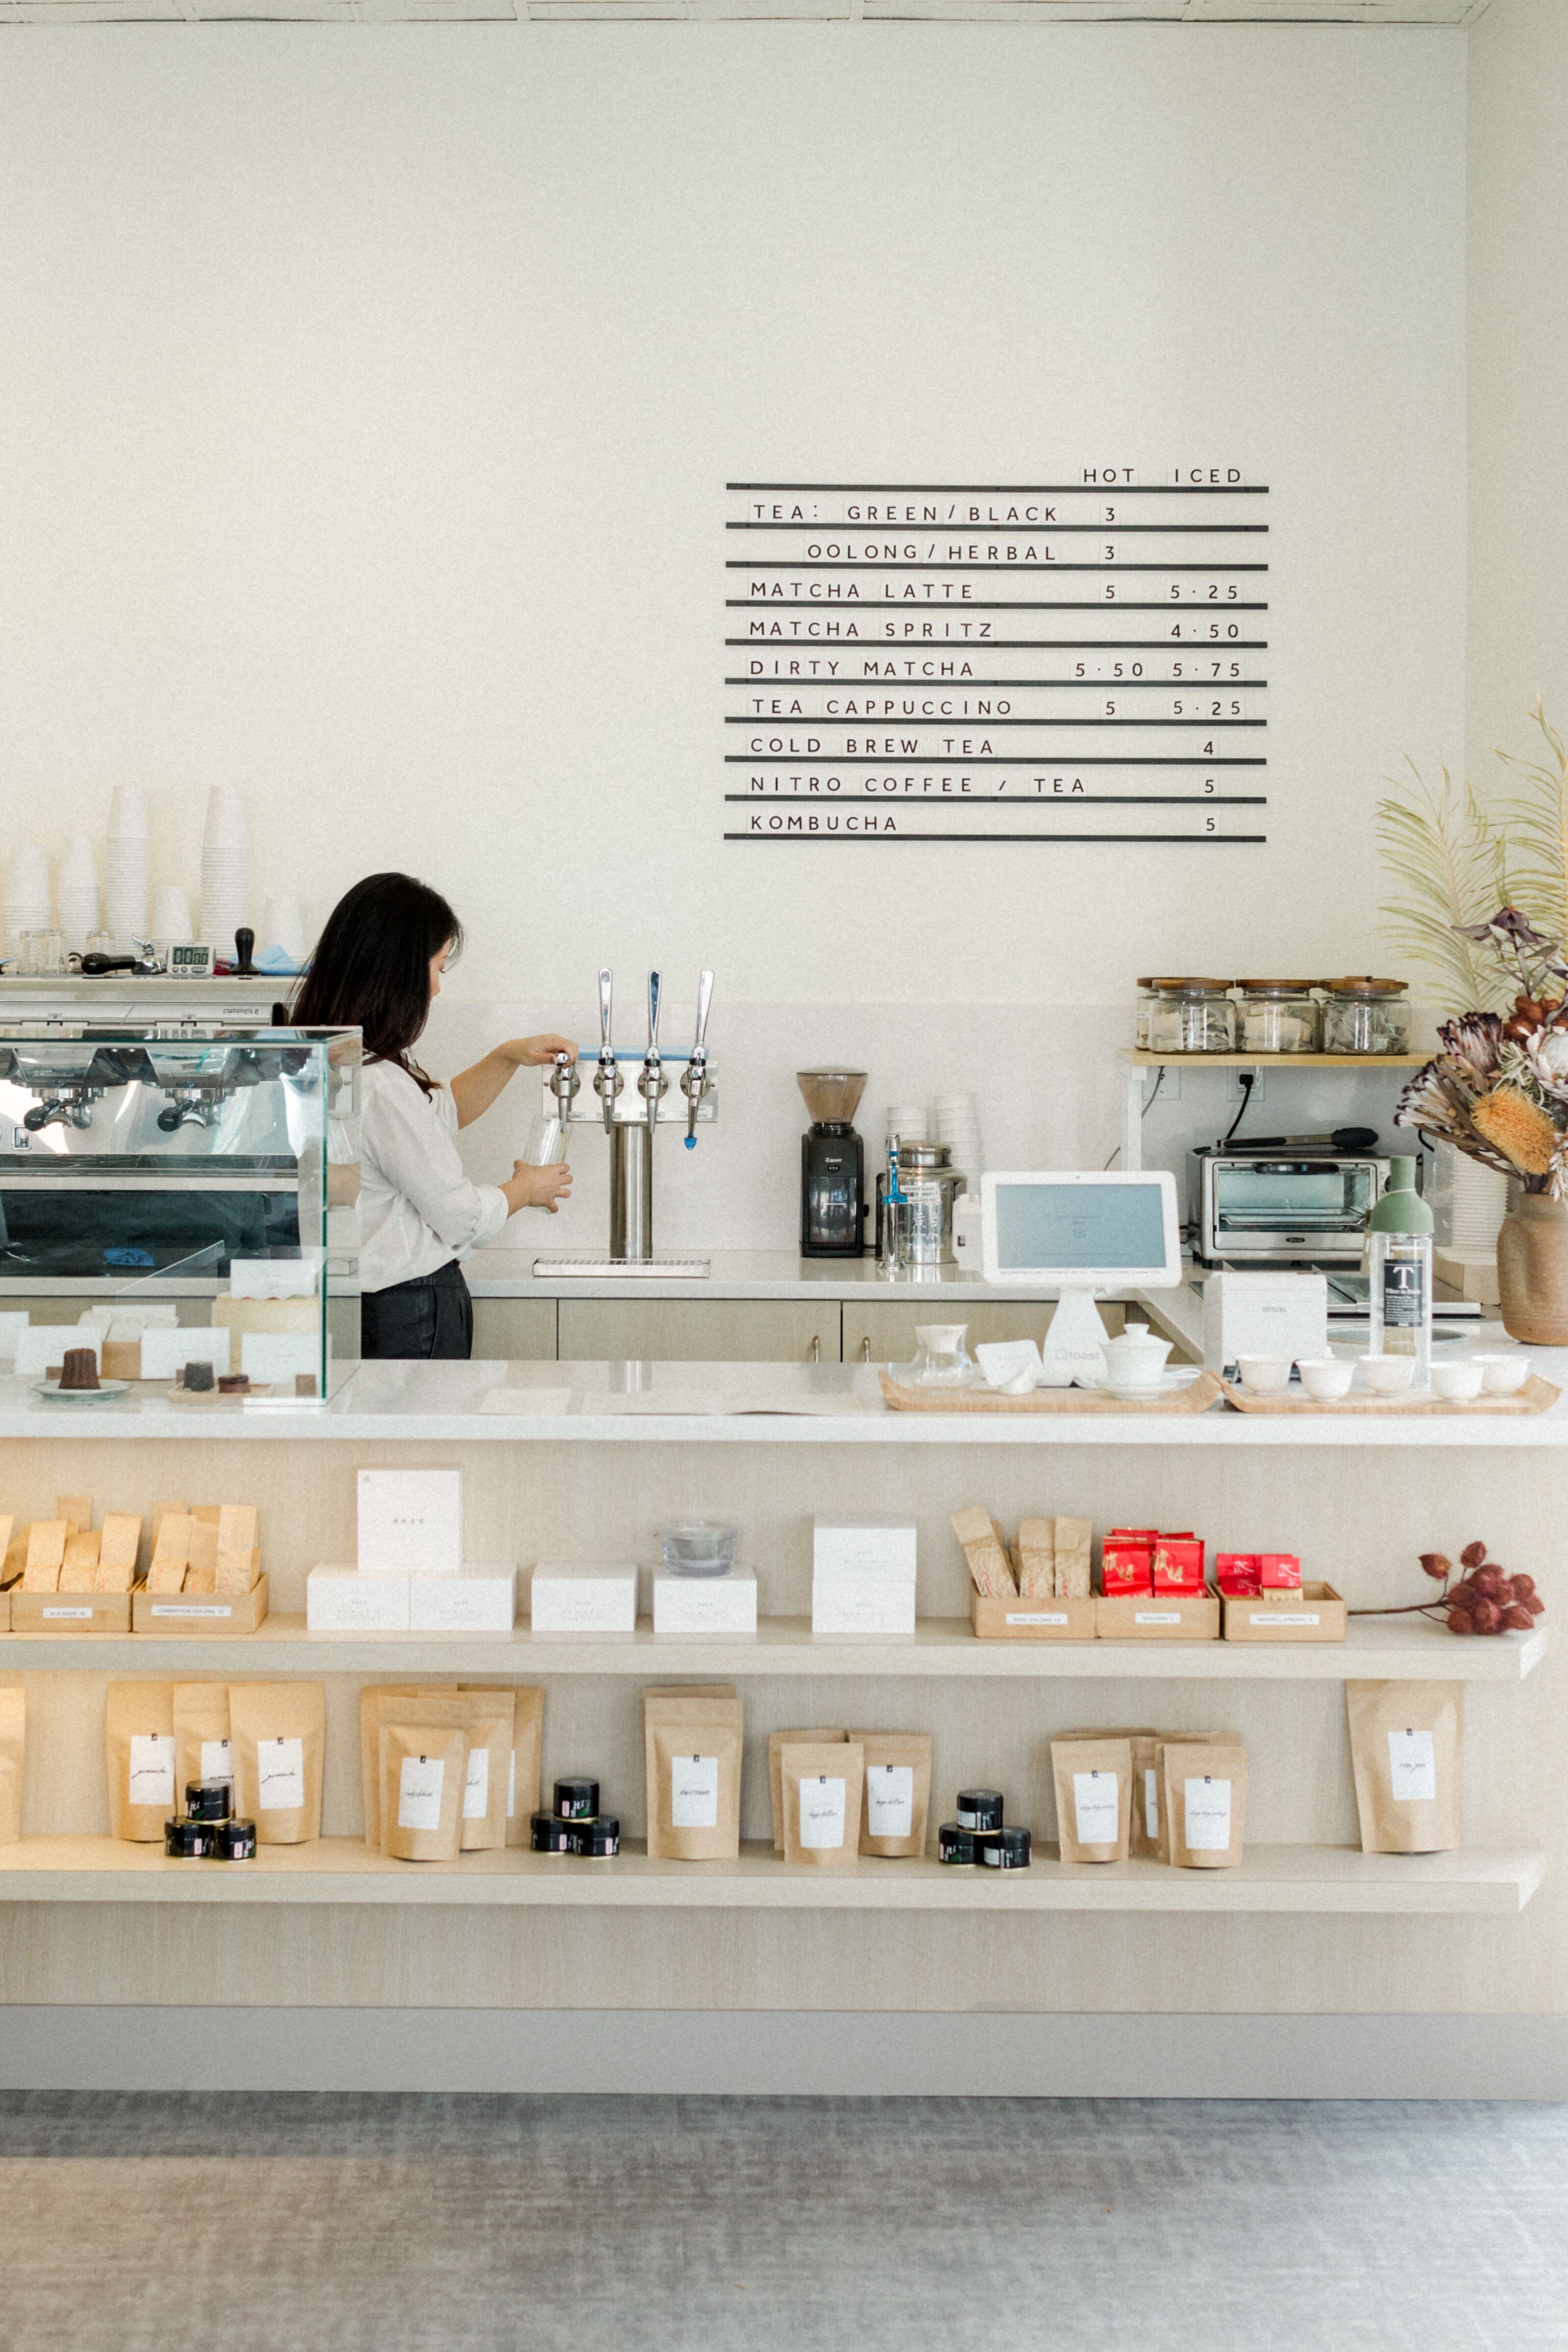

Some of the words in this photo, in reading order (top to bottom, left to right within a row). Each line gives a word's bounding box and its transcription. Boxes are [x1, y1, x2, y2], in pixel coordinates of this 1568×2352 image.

[1084, 468, 1134, 483] HOT
[1175, 469, 1240, 483] ICED
[753, 505, 817, 519] TEA:
[1105, 508, 1115, 521] 3
[1105, 546, 1114, 560] 3
[751, 582, 859, 597] MATCHA
[885, 584, 971, 598] LATTE
[1105, 585, 1114, 599] 5
[750, 621, 858, 637] MATCHA
[886, 623, 991, 637] SPRITZ
[751, 661, 839, 675] DIRTY
[864, 662, 973, 676] MATCHA
[752, 699, 802, 714] TEA
[827, 700, 1010, 715] CAPPUCCINO
[1106, 701, 1115, 715] 5
[751, 738, 821, 752] COLD
[847, 739, 918, 753] BREW
[943, 739, 992, 754] TEA
[1204, 741, 1213, 755] 4
[751, 777, 841, 791] NITRO
[865, 777, 971, 792] COFFEE
[999, 780, 1006, 791] /
[1034, 778, 1084, 793] TEA
[1205, 779, 1214, 793] 5
[751, 816, 896, 830] KOMBUCHA
[1207, 818, 1215, 831] 5
[1393, 1266, 1414, 1289] T
[1069, 1351, 1100, 1360] toast
